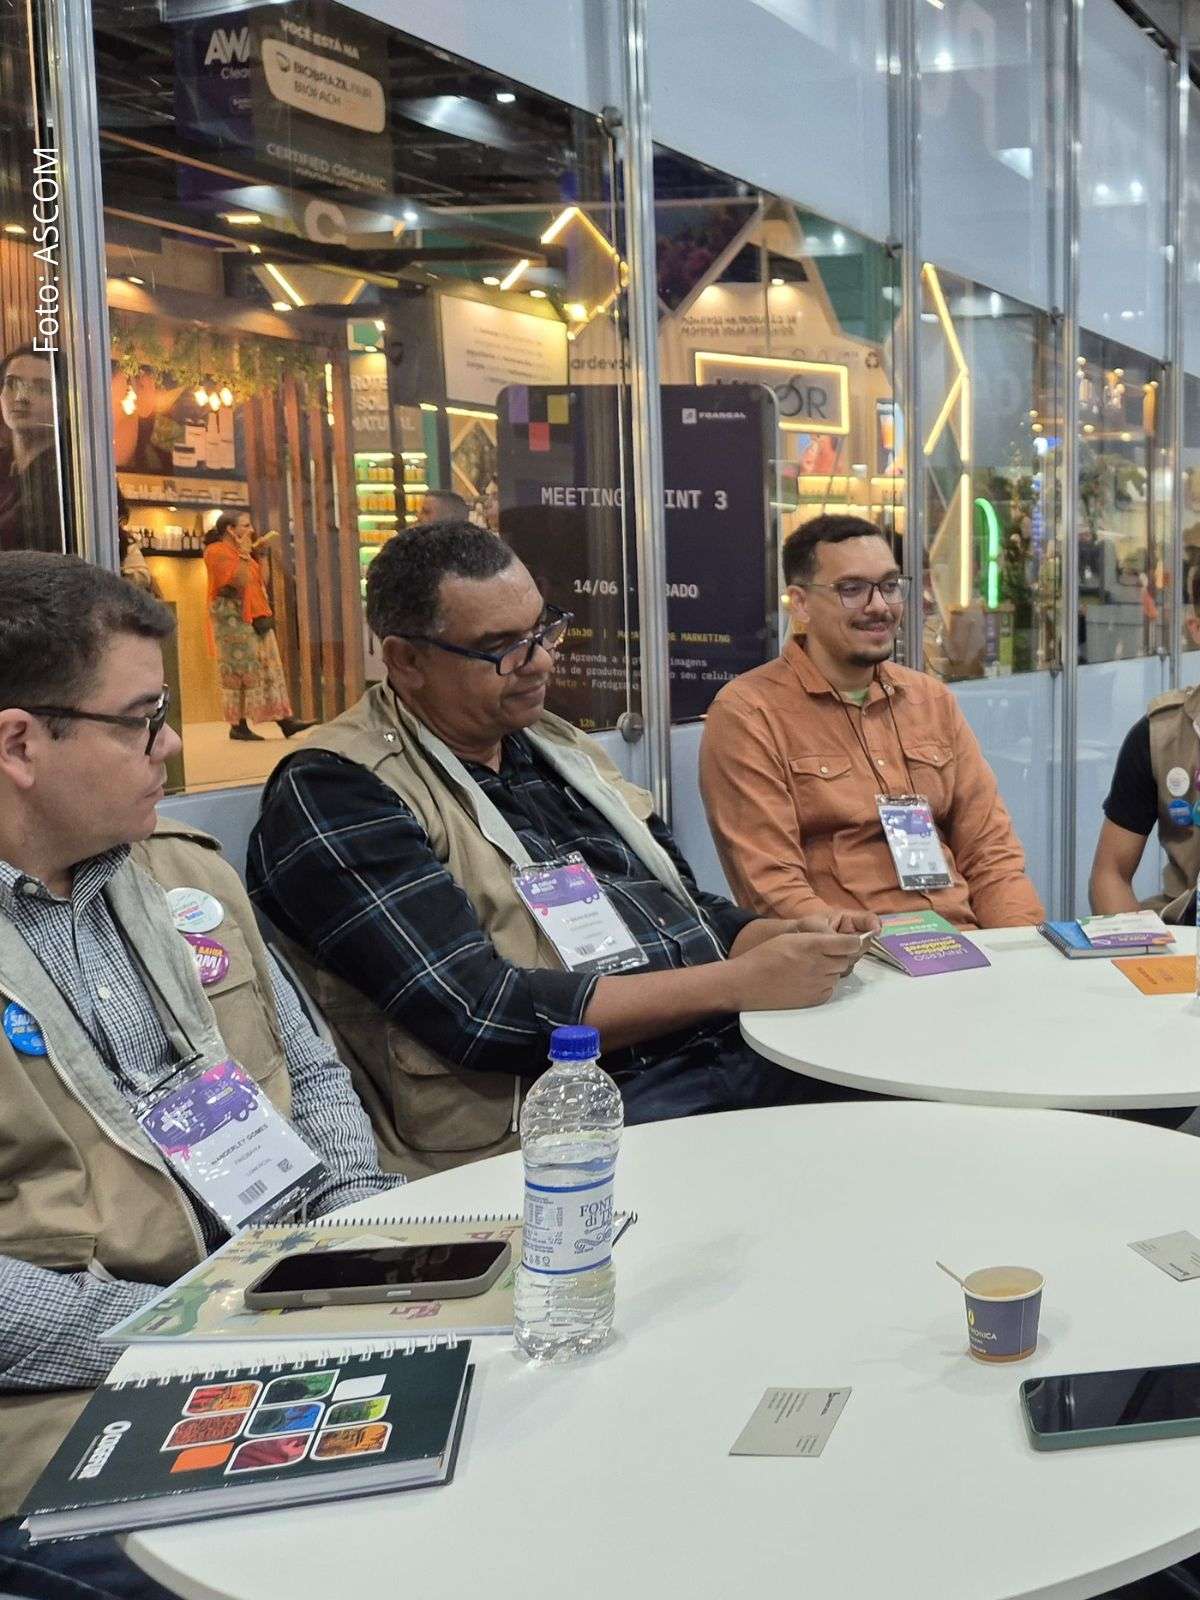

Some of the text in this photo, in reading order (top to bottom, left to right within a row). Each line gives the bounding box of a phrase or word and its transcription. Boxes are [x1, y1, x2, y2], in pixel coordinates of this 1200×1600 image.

[541, 486, 729, 511] MEETING INT 3
[573, 579, 700, 599] 14/06 BADO
